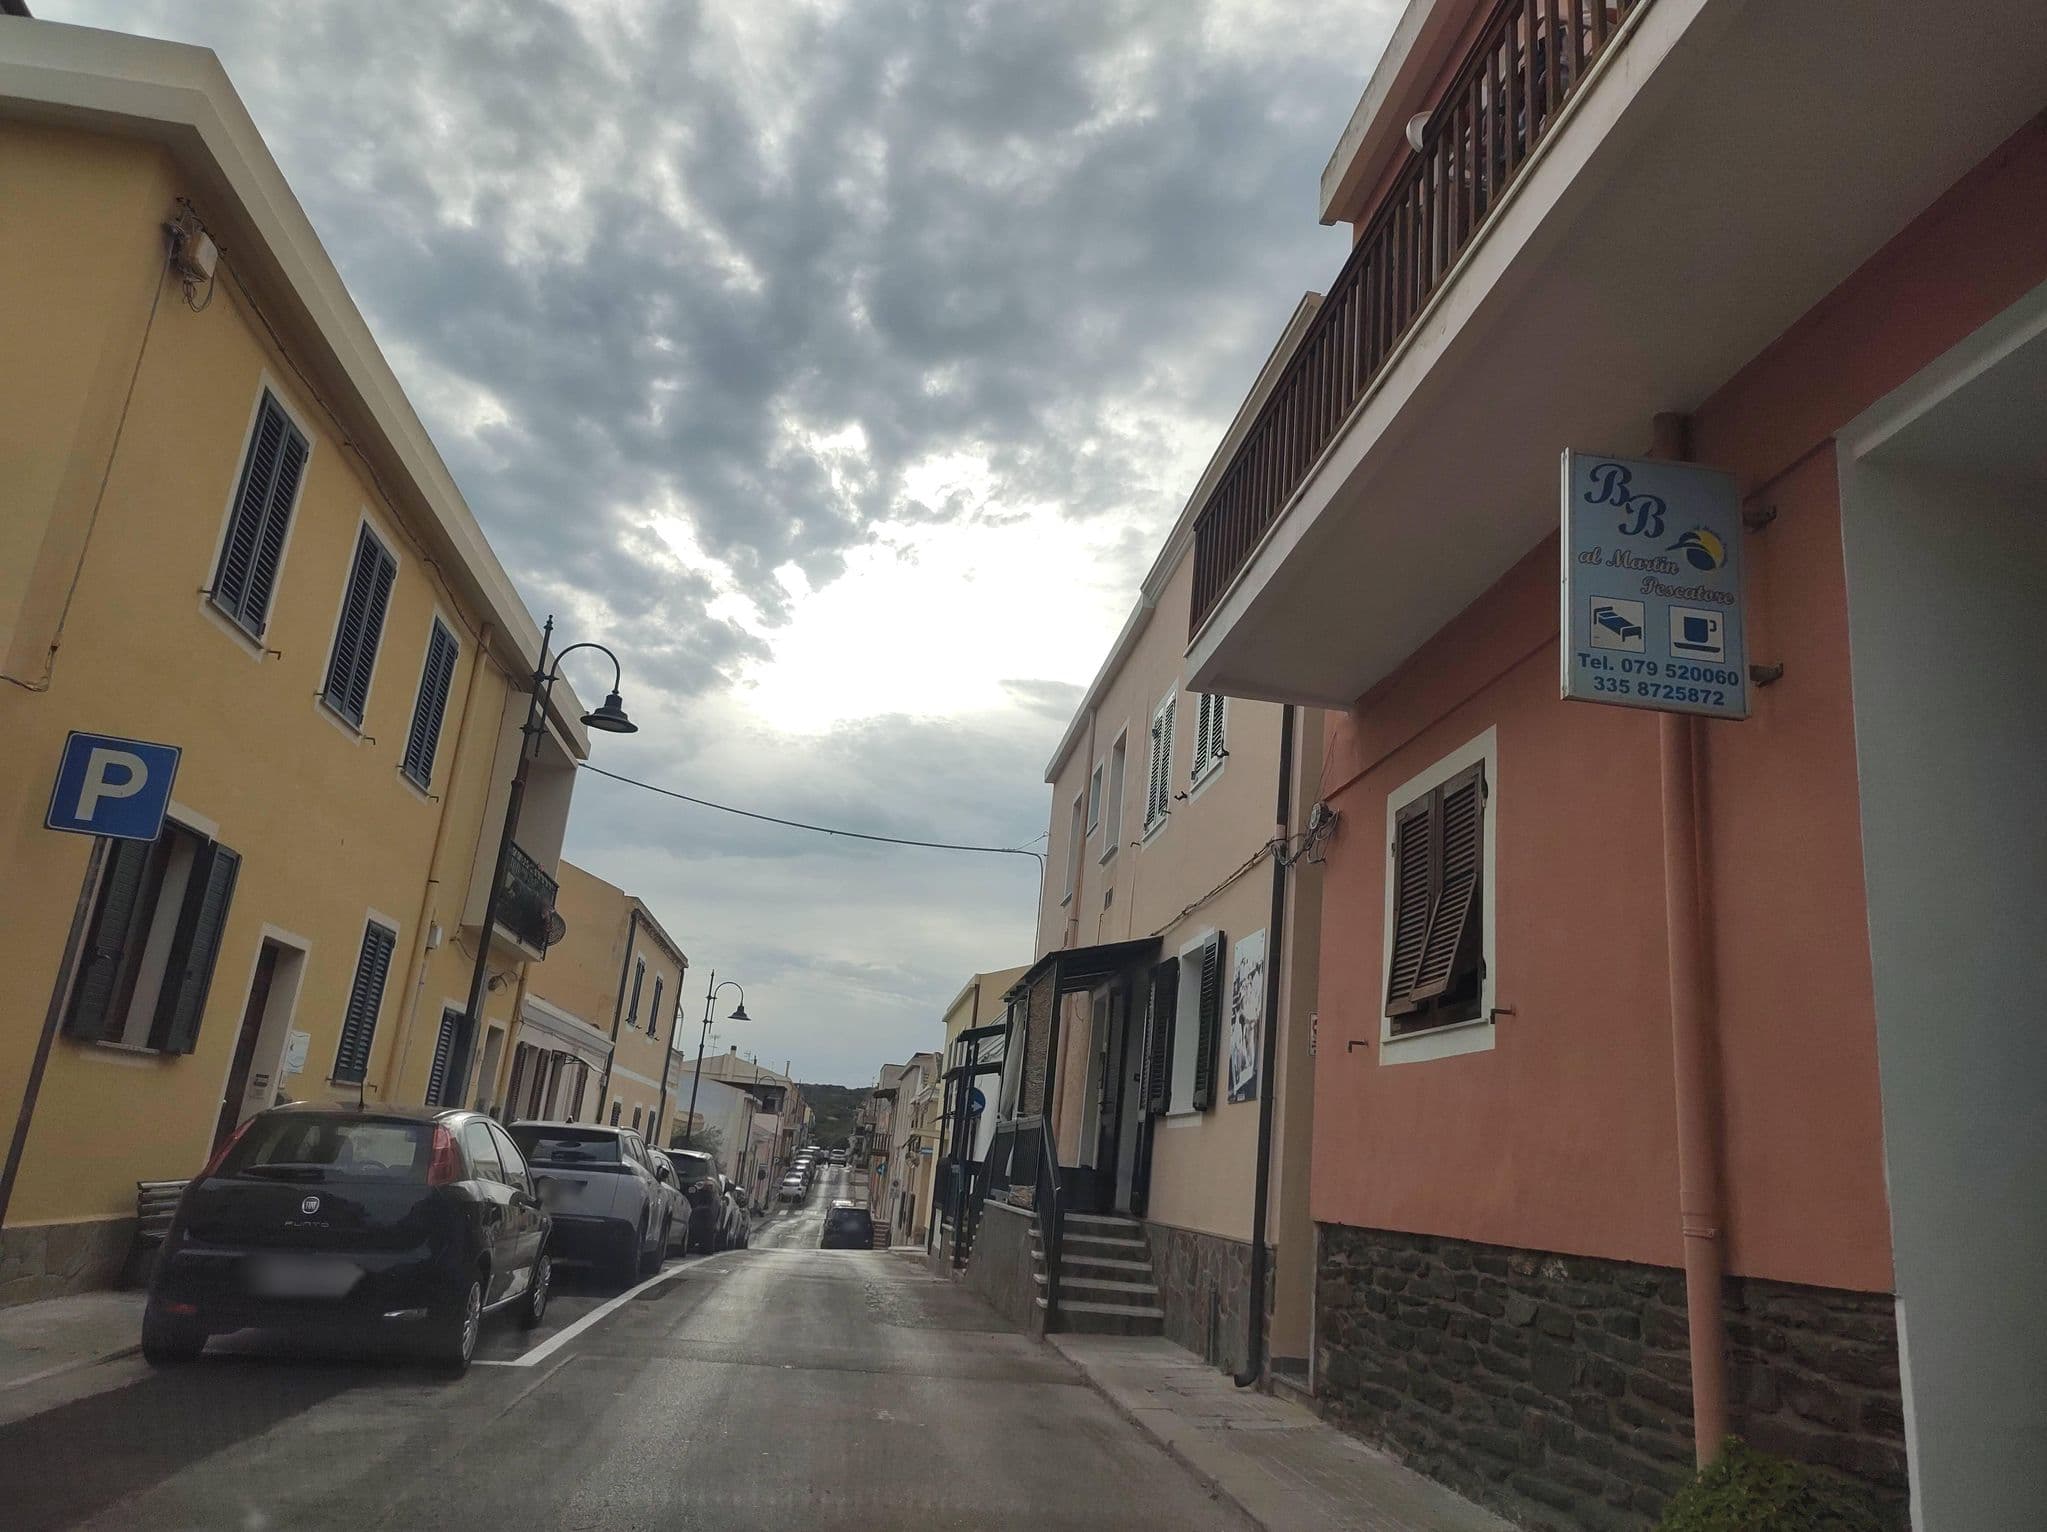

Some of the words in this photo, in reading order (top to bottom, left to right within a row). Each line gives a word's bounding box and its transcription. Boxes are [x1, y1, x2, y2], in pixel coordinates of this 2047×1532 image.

[1578, 546, 1602, 566] al
[1606, 549, 1680, 575] Martin
[1640, 576, 1735, 605] Pescatore
[1577, 653, 1614, 671] Tel.
[1621, 658, 1658, 676] 079
[1666, 664, 1739, 686] 520060
[1594, 676, 1630, 694] 335
[1637, 681, 1725, 706] 8725872
[75, 747, 148, 821] P
